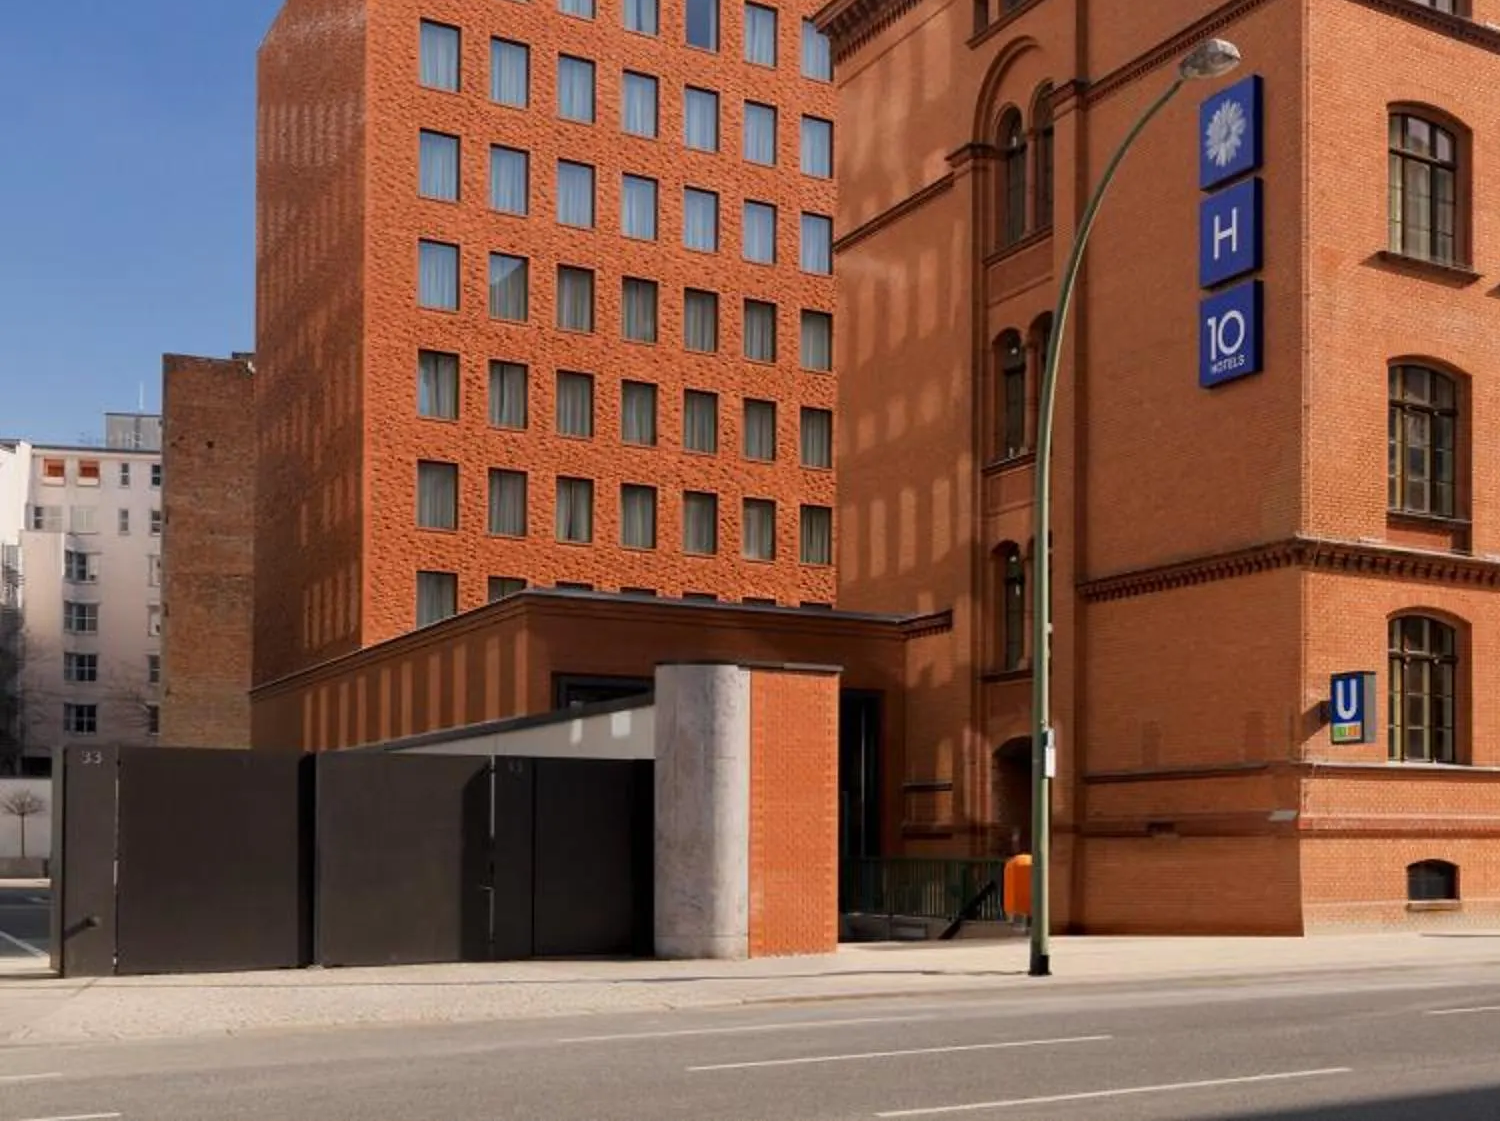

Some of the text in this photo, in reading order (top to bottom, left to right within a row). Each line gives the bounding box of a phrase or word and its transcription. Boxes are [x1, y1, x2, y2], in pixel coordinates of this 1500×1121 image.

[1213, 207, 1237, 260] H
[1206, 310, 1245, 361] 10
[1211, 354, 1245, 375] HOTELS
[1336, 678, 1357, 719] U
